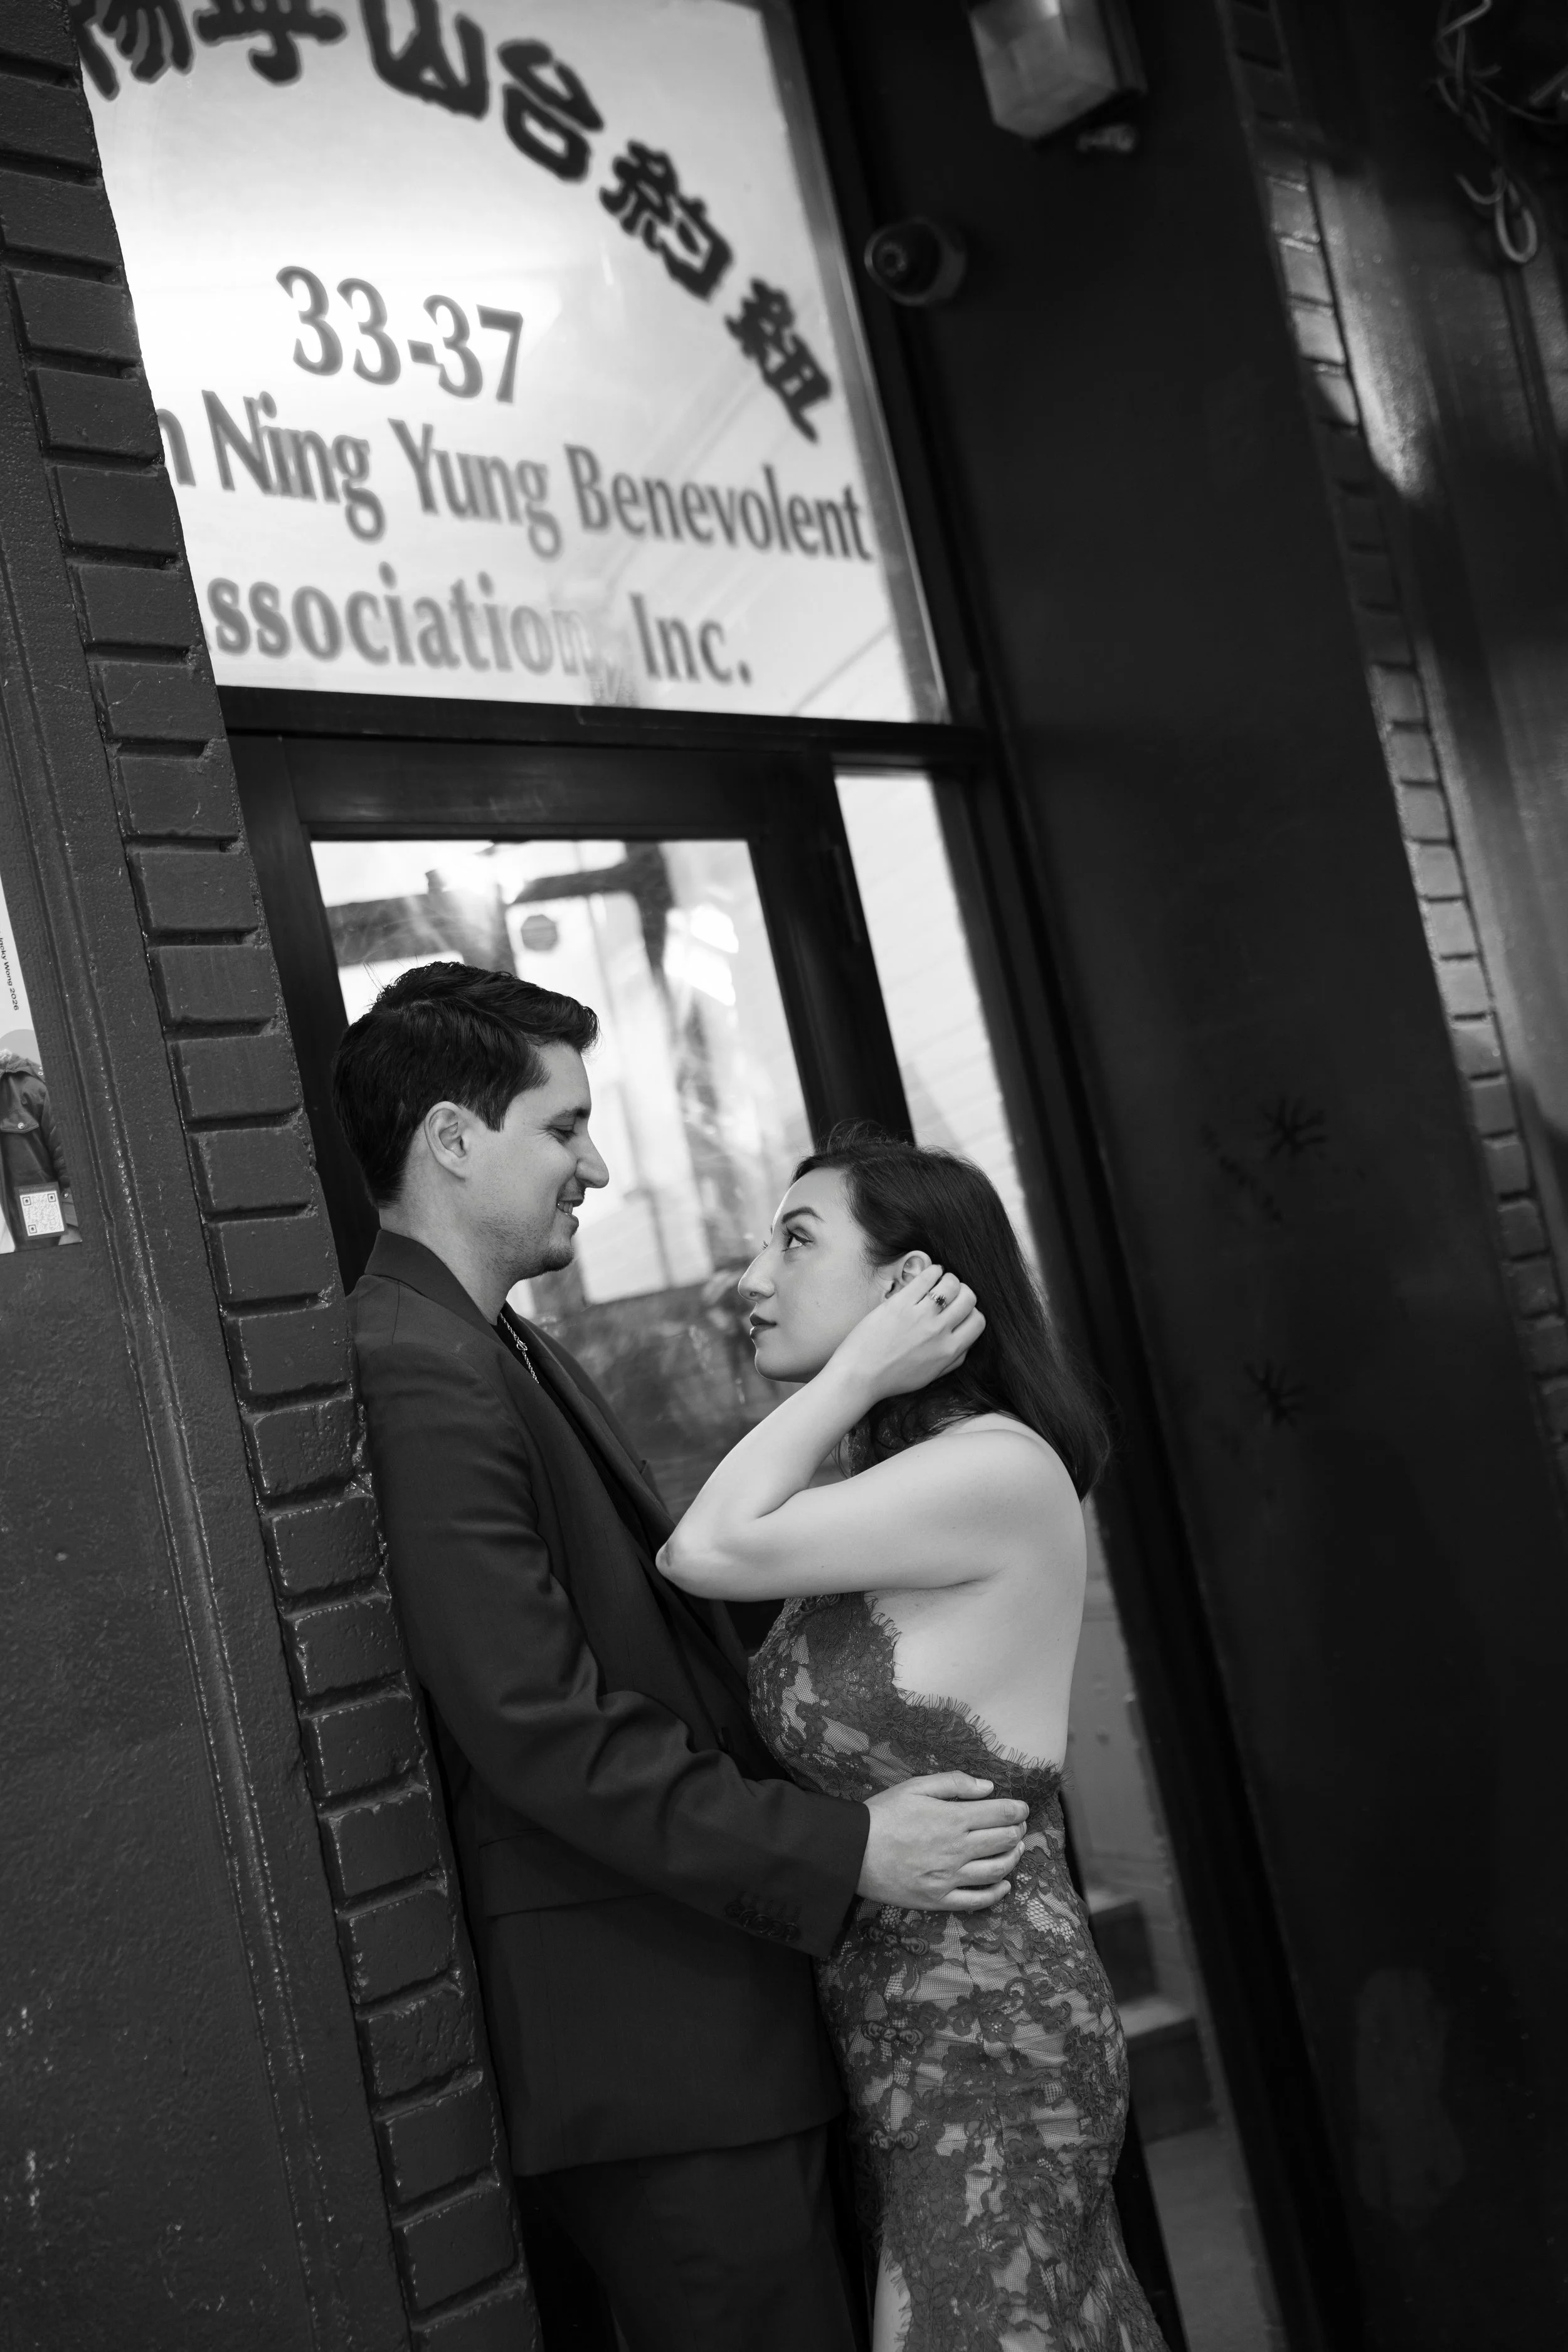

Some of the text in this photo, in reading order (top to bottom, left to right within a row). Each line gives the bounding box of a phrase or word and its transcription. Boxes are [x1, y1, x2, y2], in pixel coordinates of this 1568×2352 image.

[276, 266, 523, 403] 33-37
[201, 389, 386, 544] Ning
[388, 418, 562, 561] Yung
[564, 443, 873, 561] Benevolent
[207, 561, 753, 685] ssociation Inc.
[4, 961, 13, 986] Wong
